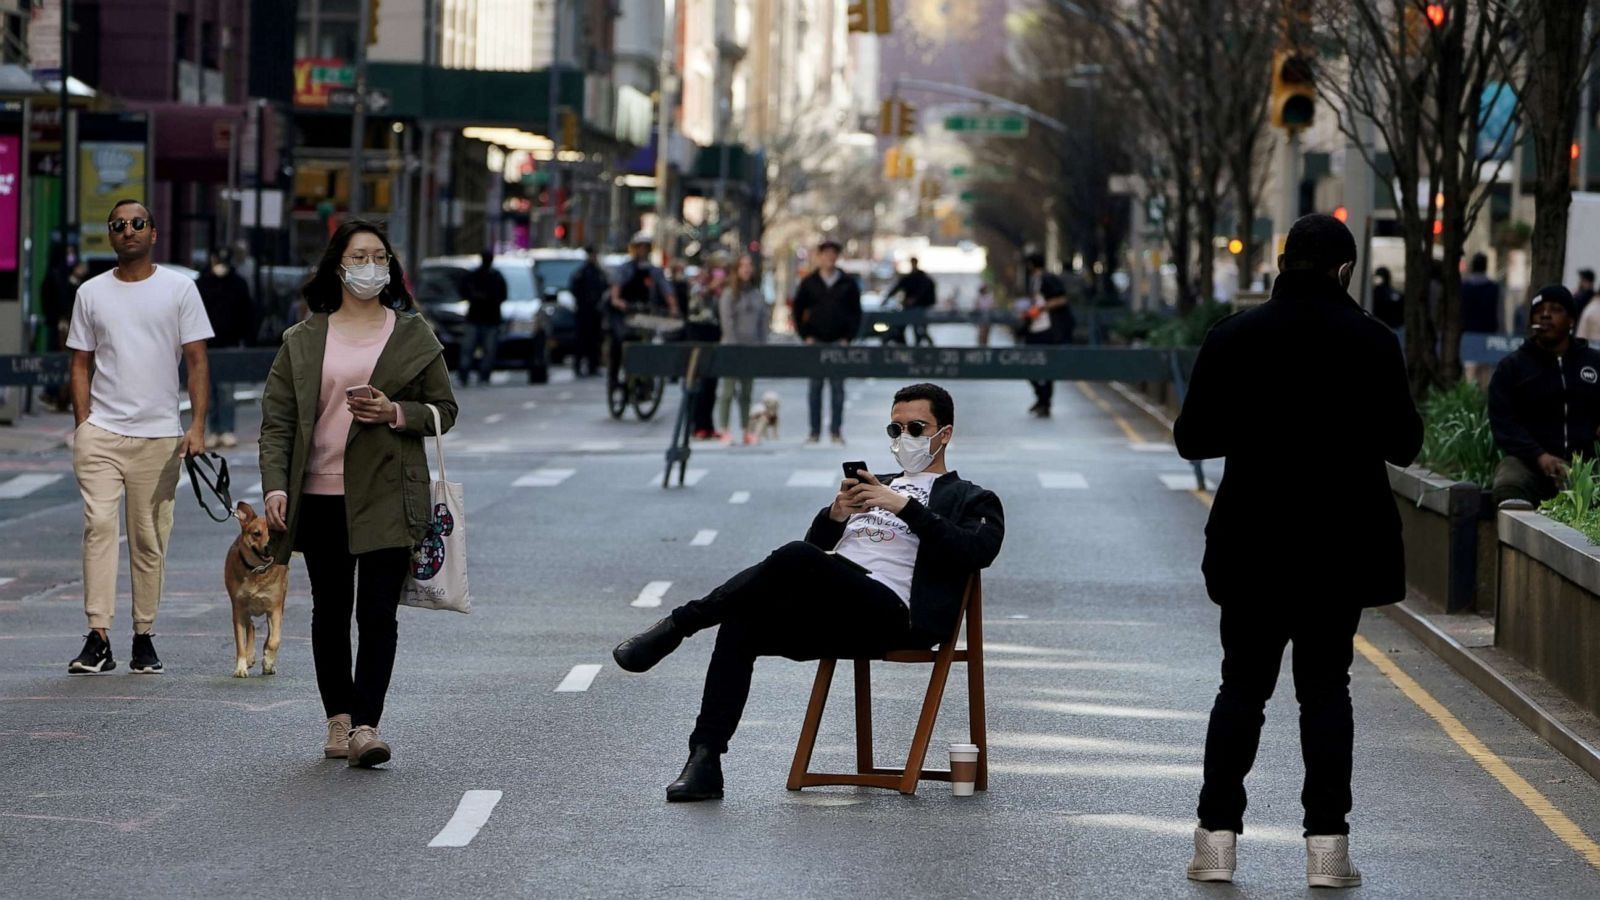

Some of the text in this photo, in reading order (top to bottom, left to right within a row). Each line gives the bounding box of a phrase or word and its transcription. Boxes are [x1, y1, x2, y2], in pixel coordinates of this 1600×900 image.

[11, 357, 42, 372] LINE
[820, 349, 870, 364] POLICE
[883, 350, 914, 364] LINE
[939, 350, 960, 365] DO
[964, 350, 992, 365] NOT
[998, 351, 1047, 366] CROSS
